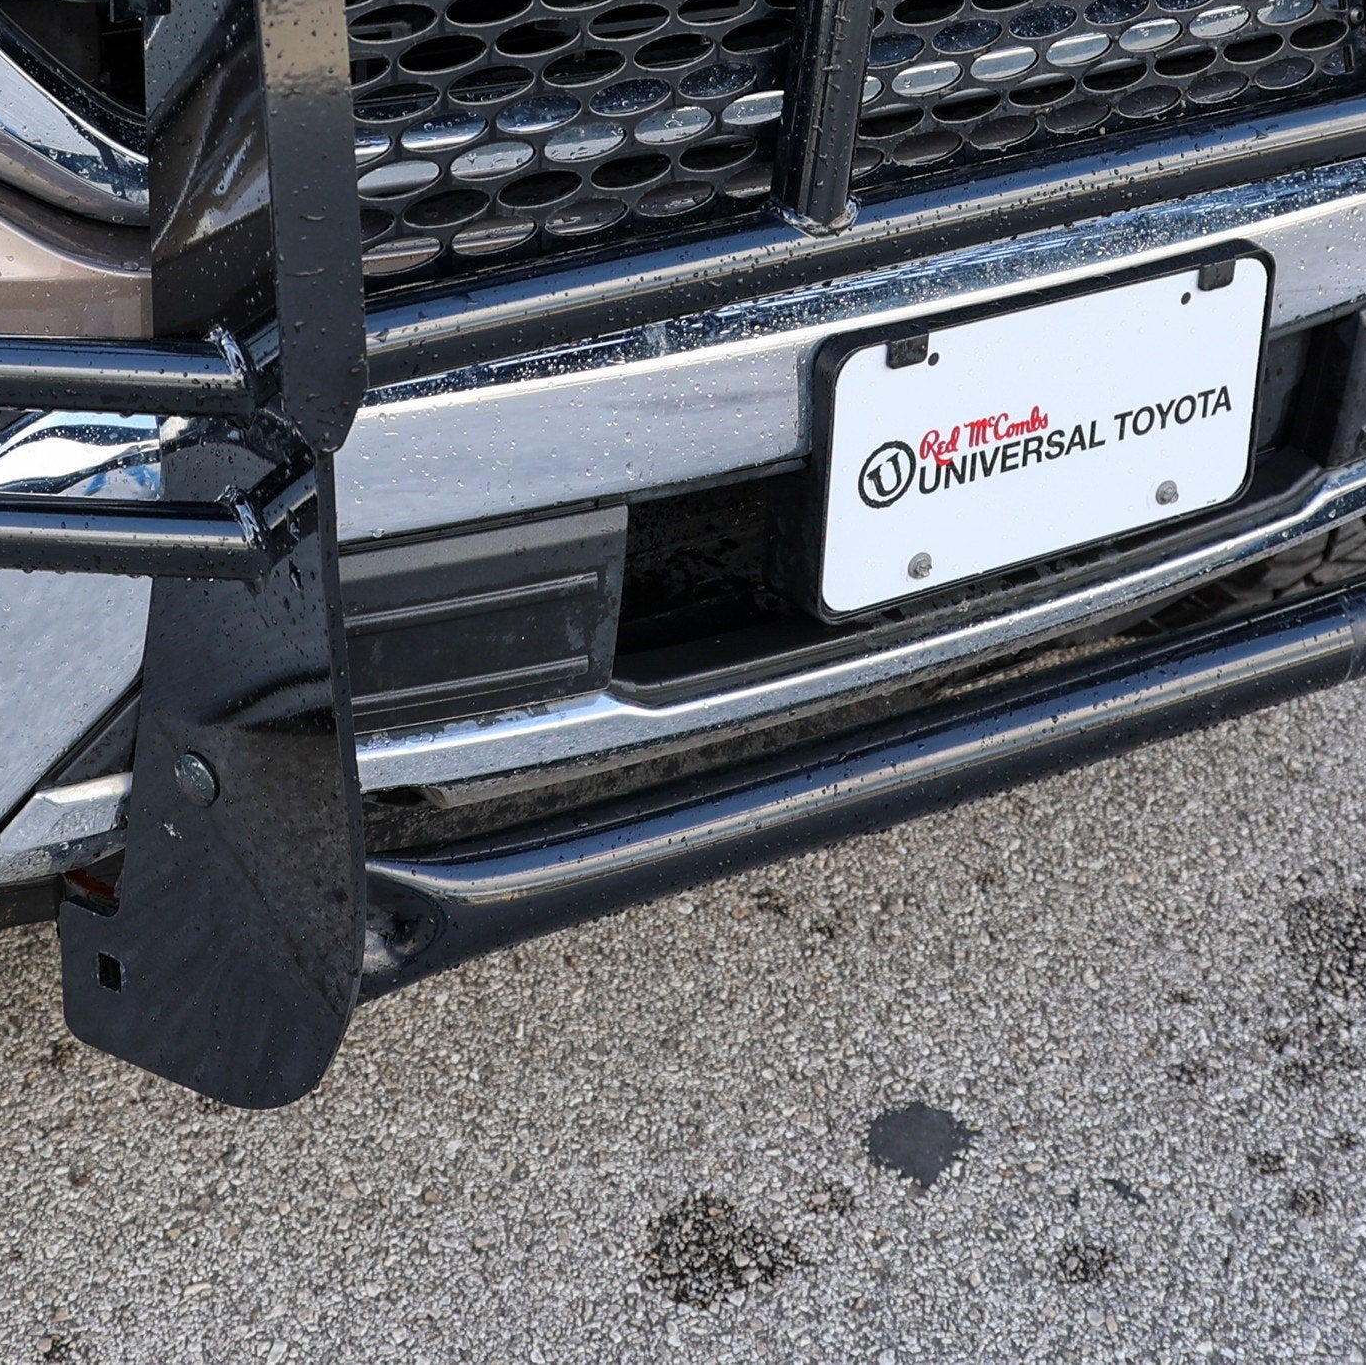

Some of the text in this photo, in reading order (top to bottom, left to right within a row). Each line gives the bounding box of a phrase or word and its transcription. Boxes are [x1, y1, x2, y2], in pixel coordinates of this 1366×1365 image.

[919, 405, 1049, 466] Red McCombs
[919, 385, 1232, 495] UNIVERSAL TOYOTA
